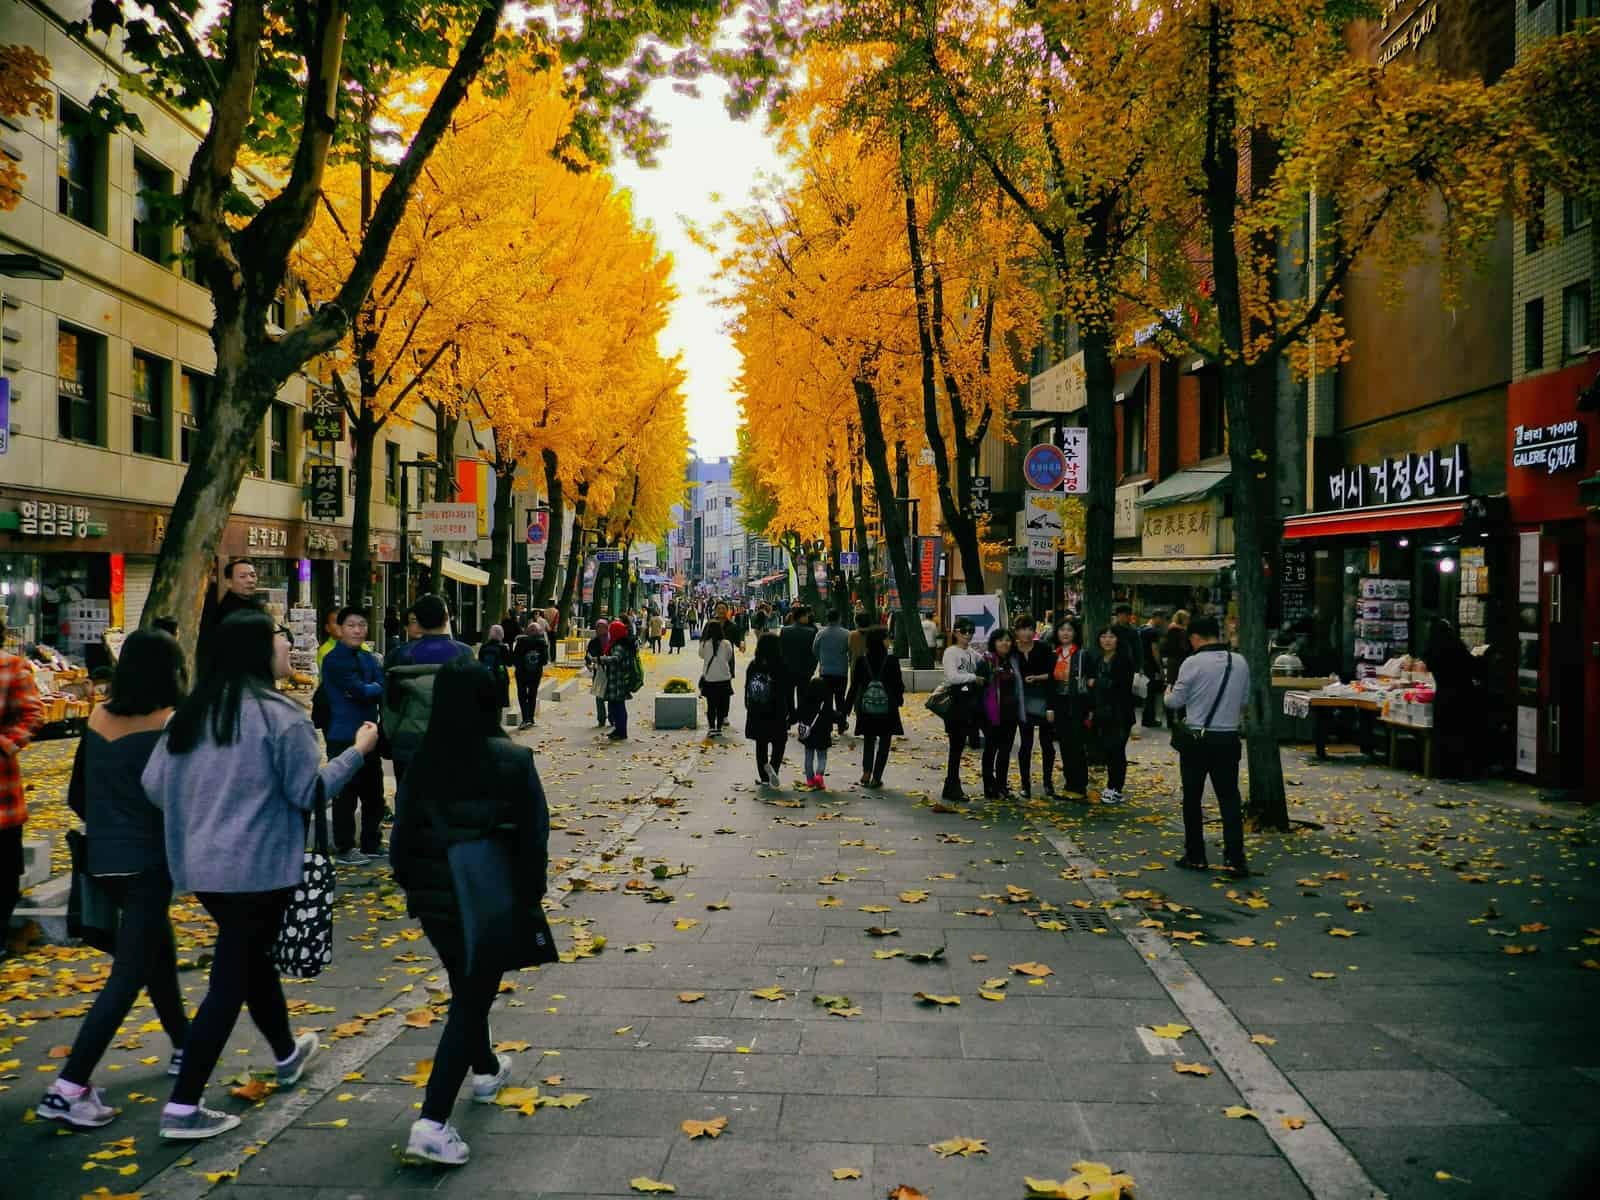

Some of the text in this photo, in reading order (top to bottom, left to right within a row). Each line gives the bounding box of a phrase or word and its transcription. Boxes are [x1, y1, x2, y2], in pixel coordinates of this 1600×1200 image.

[1546, 420, 1578, 438] 가이아
[1513, 444, 1576, 474] GALERIE GAIA
